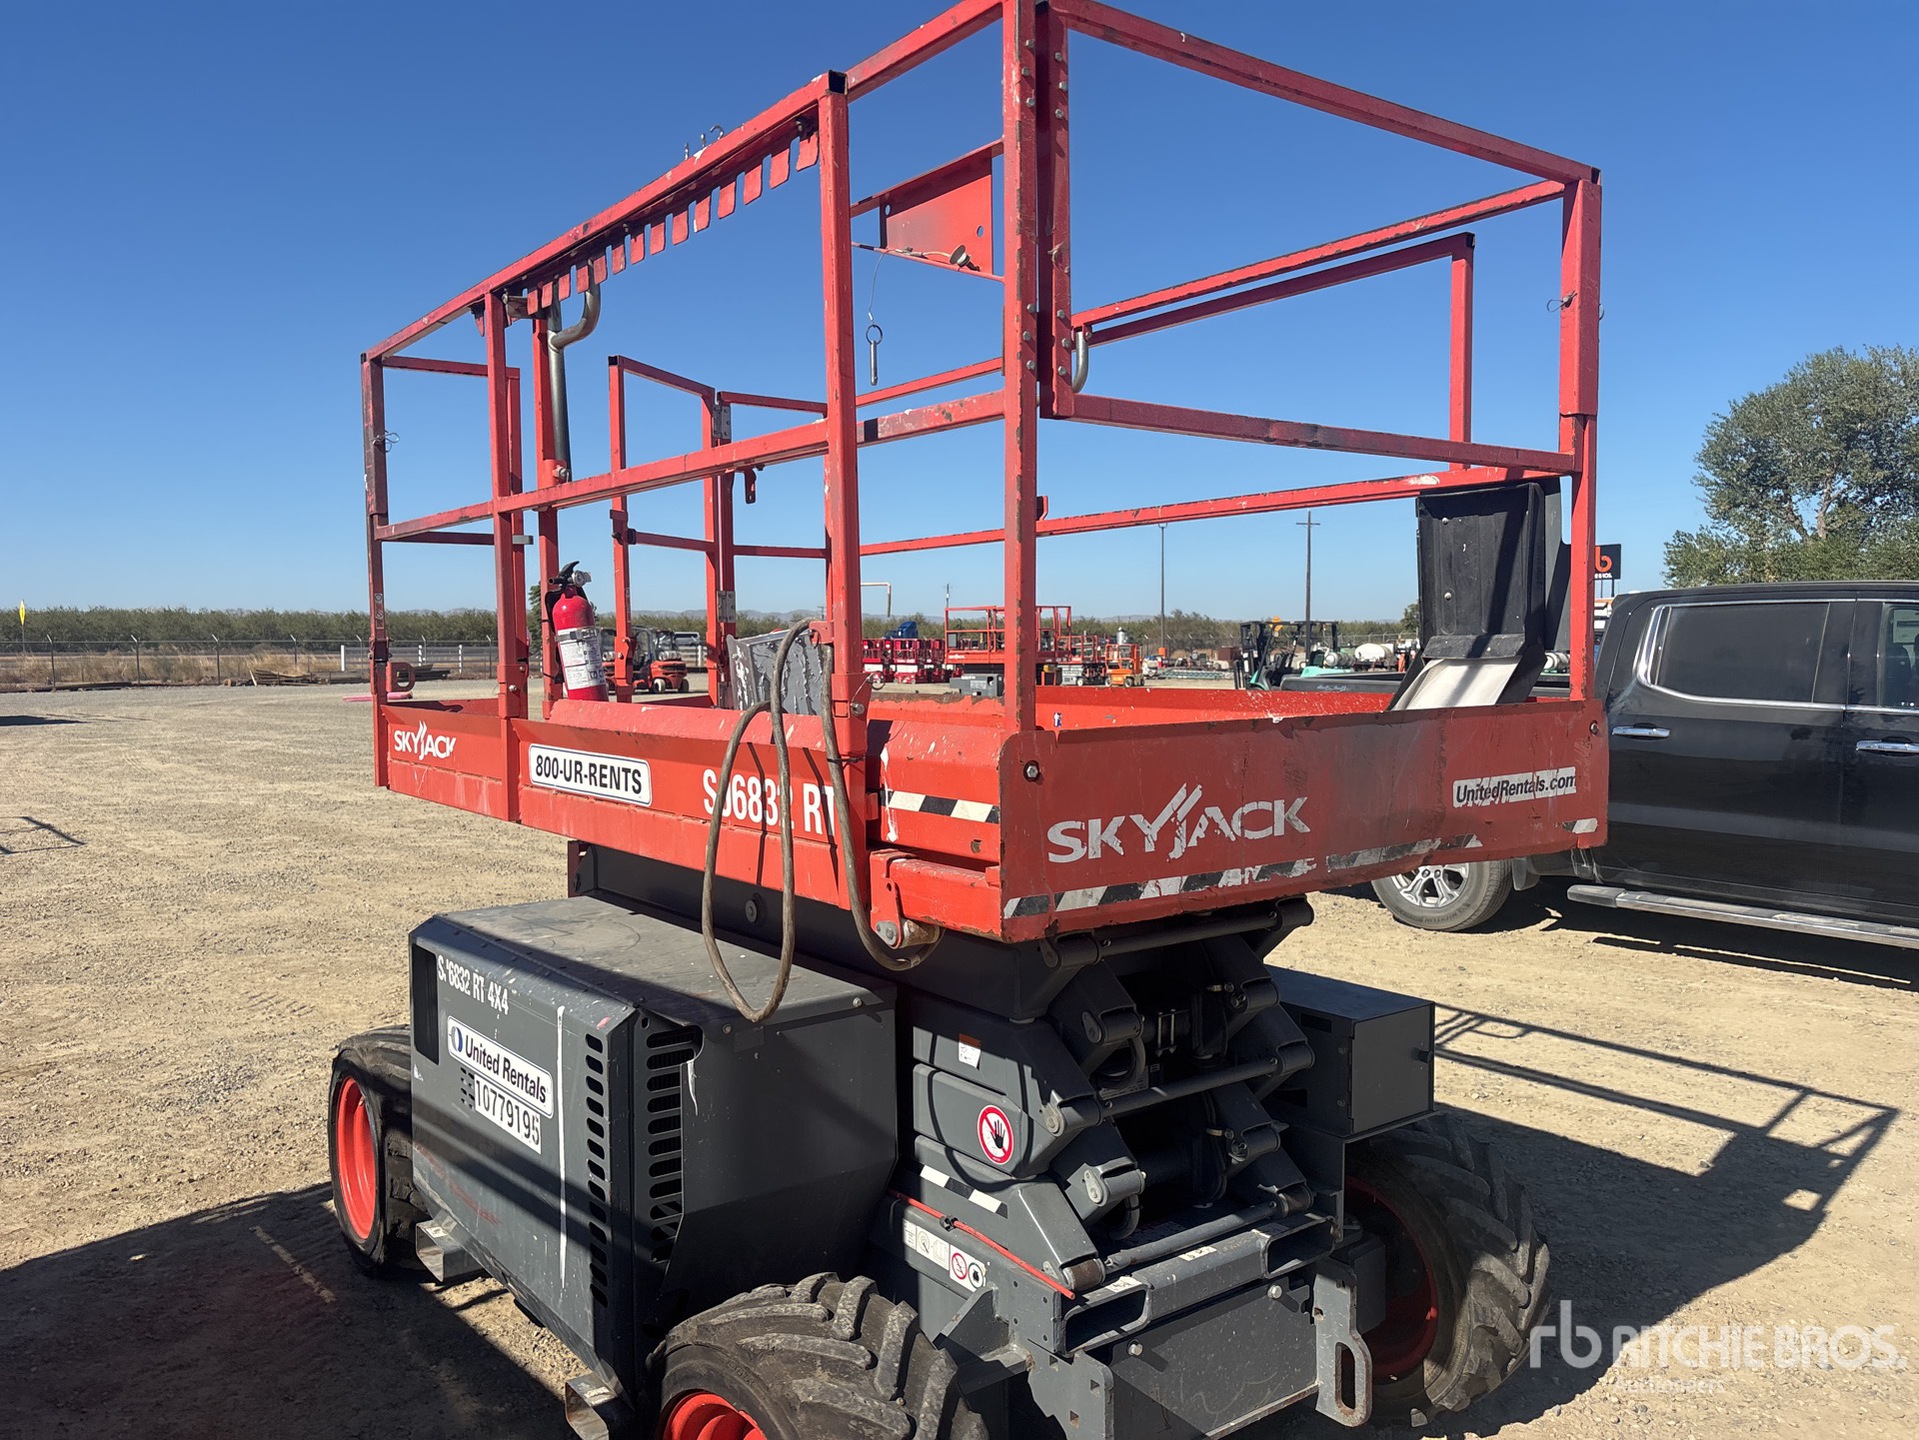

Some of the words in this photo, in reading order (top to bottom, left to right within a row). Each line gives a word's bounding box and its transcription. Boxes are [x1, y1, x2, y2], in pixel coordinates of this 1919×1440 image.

[393, 720, 457, 761] SKYJACK
[535, 755, 642, 795] 800-UR-RENTS
[703, 769, 794, 830] S683
[1456, 775, 1576, 803] UnitedRentals.com
[1047, 783, 1311, 863] SKYJACK
[472, 972, 485, 1003] RT
[465, 1034, 500, 1076] United
[502, 1056, 547, 1104] Rentals
[476, 1079, 540, 1146] 10779195
